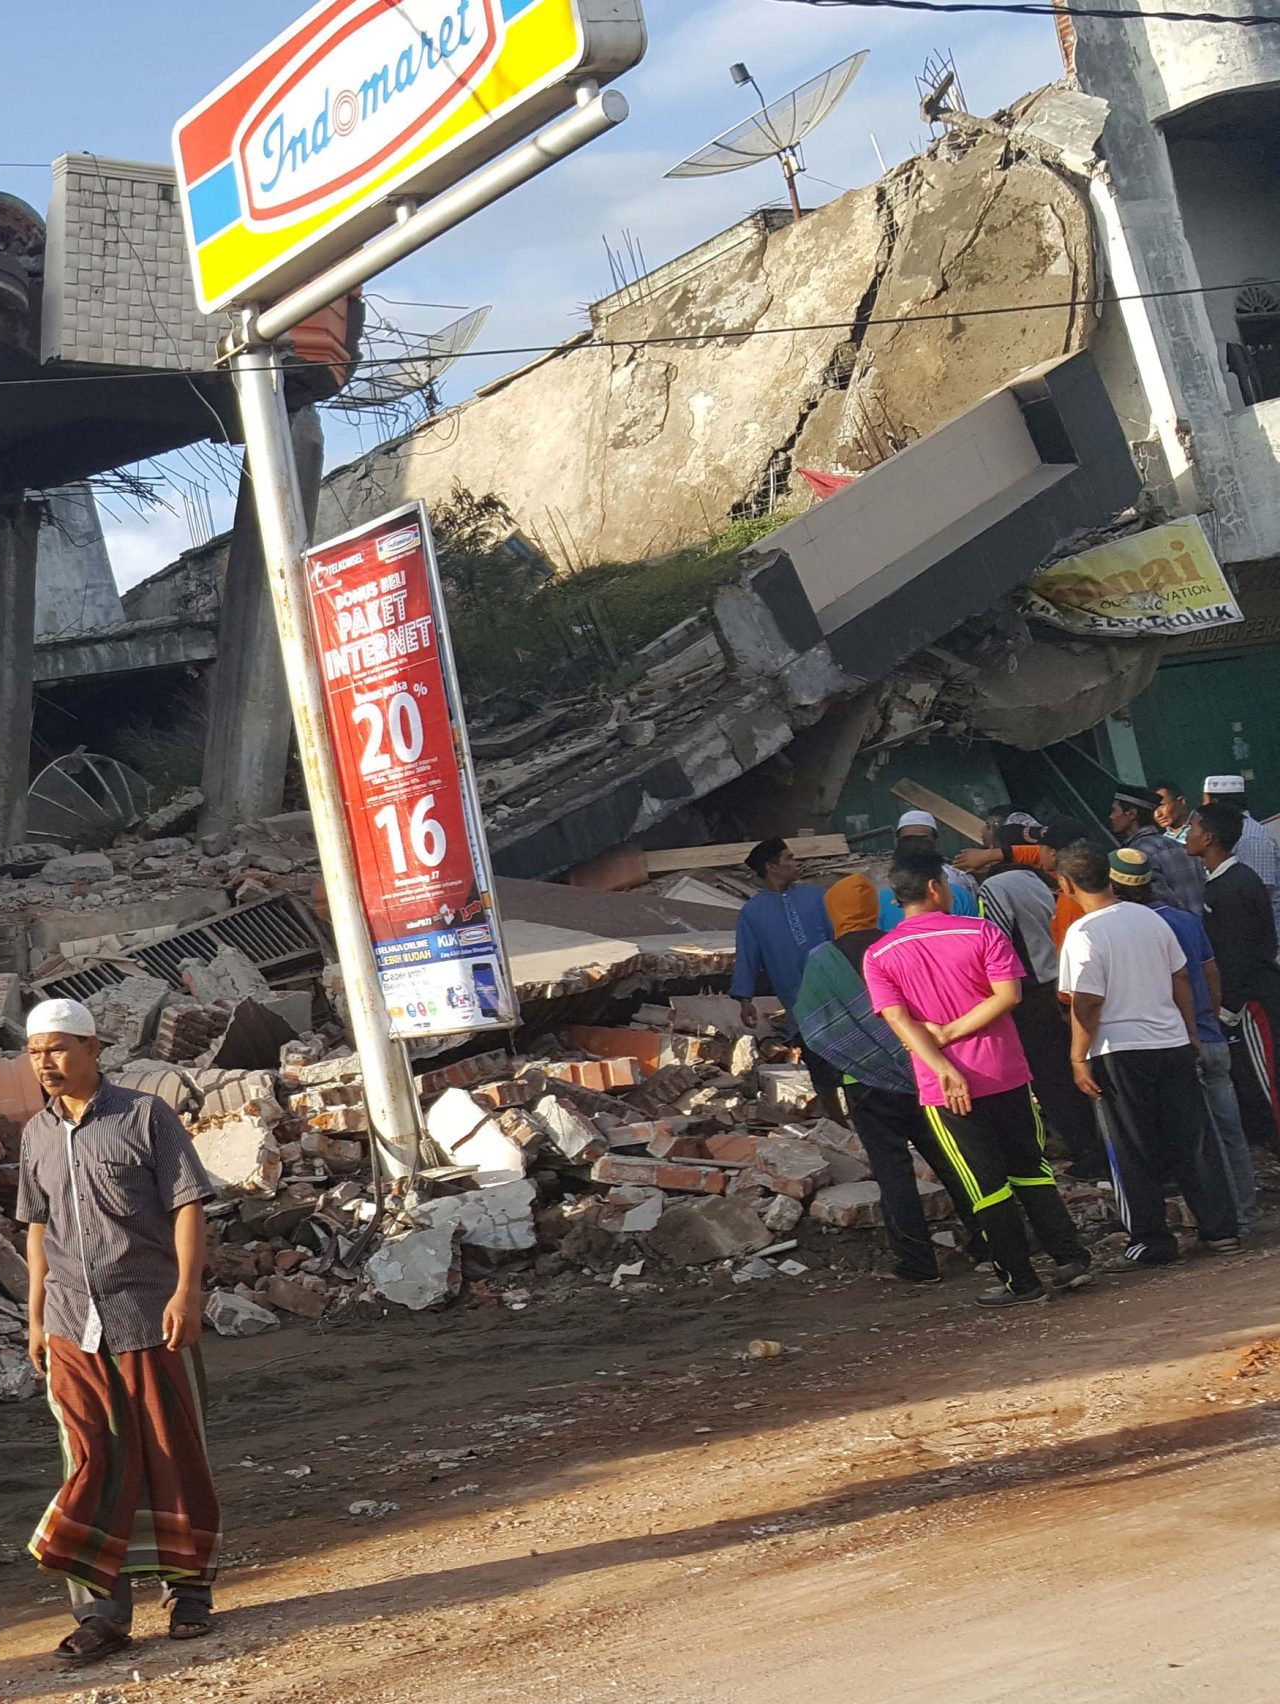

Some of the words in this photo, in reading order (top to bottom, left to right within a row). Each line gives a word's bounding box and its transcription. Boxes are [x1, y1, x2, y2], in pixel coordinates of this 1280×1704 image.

[261, 0, 476, 192] Indomaret
[335, 581, 378, 611] BONUS
[337, 589, 408, 643] PAKET
[324, 615, 432, 681] INTERNET
[382, 681, 408, 699] pulsa
[373, 793, 447, 874] 16
[402, 949, 432, 963] MUDAH
[403, 938, 430, 951] ONLINE
